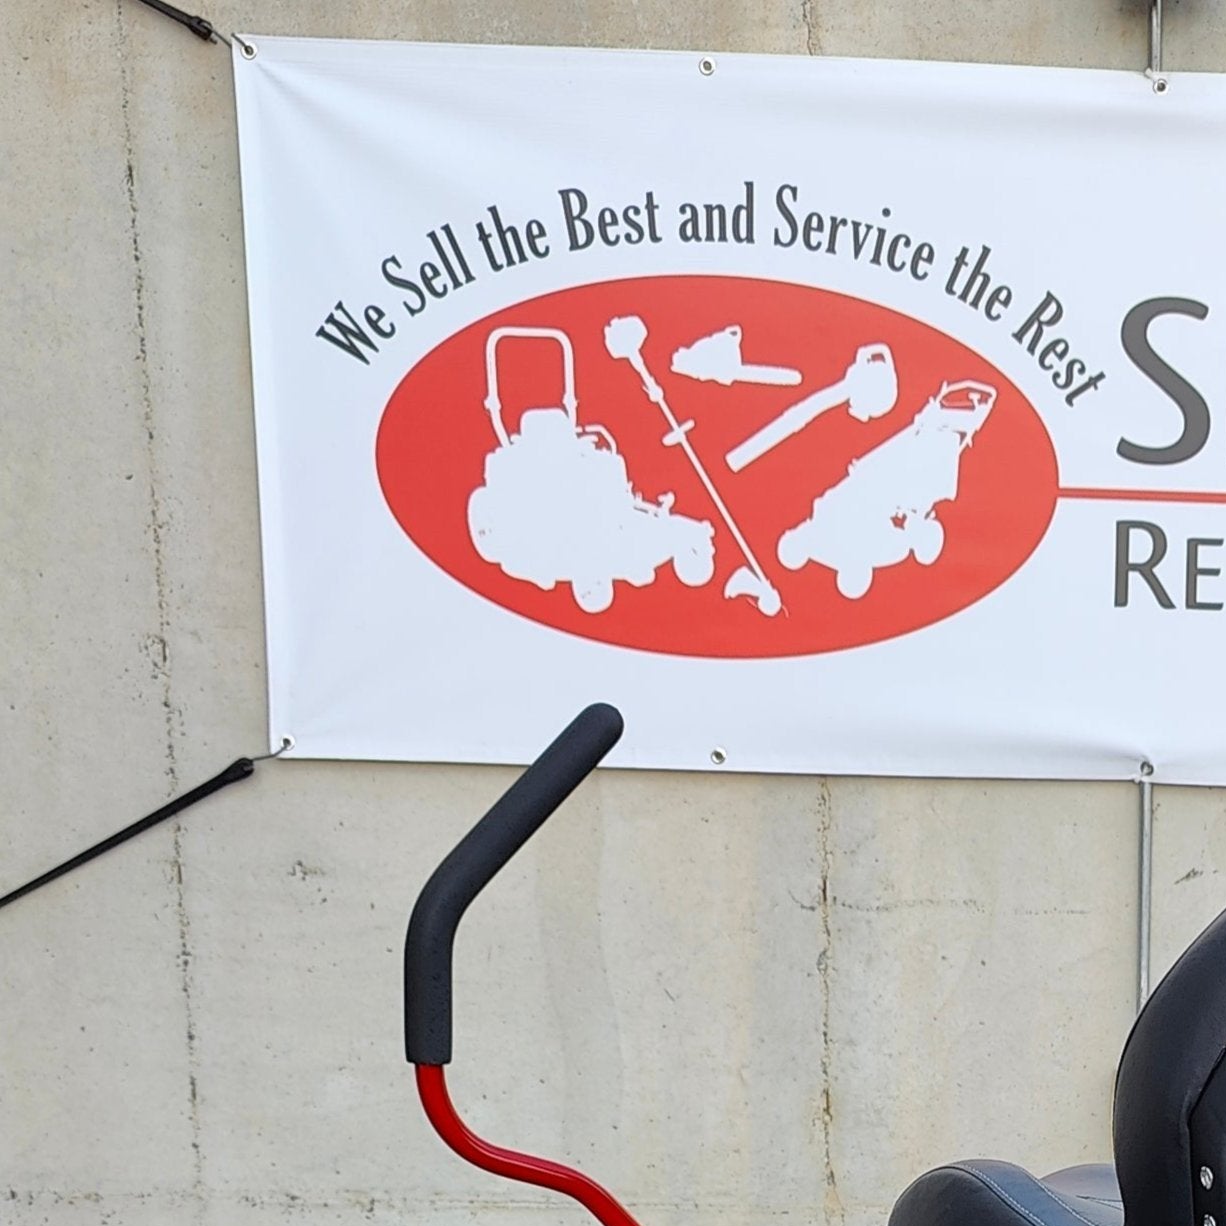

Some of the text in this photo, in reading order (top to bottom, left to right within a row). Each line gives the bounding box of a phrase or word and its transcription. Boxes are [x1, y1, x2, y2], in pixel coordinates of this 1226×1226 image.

[316, 181, 1106, 407] We Sell the Best and Service the Rest
